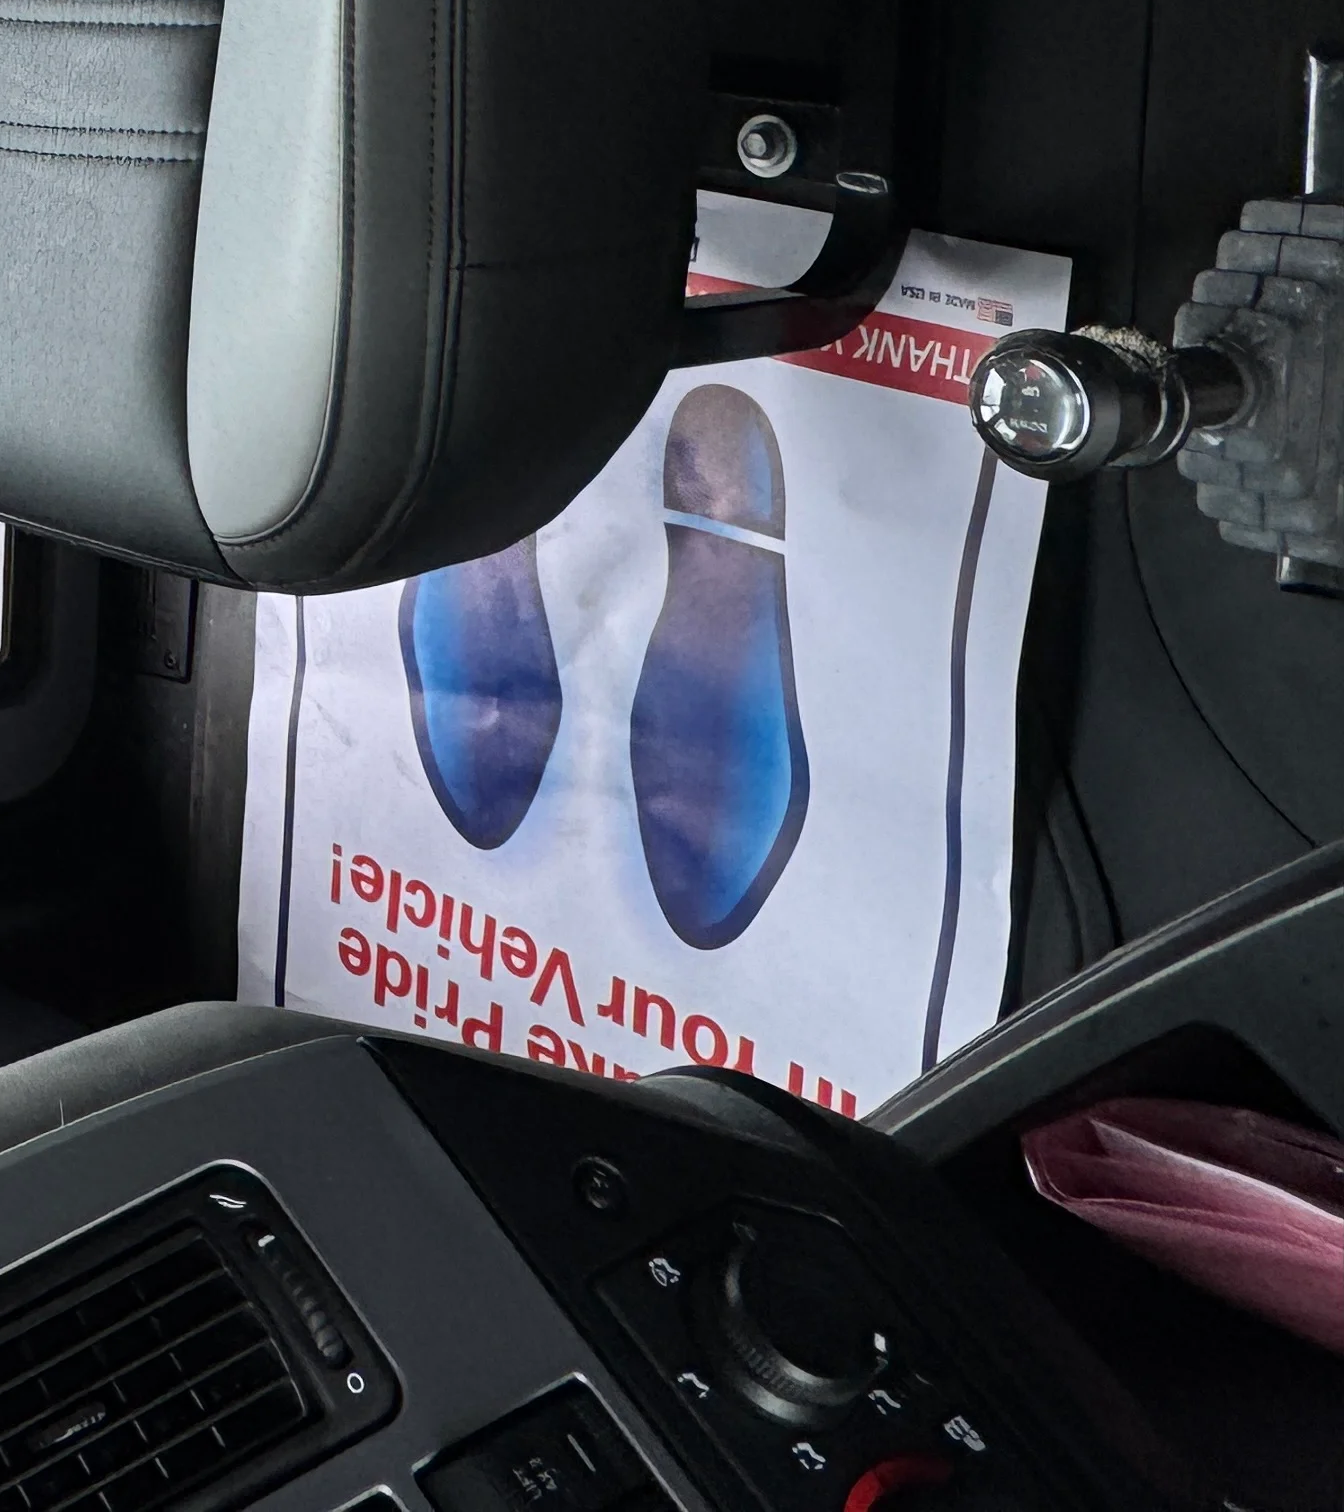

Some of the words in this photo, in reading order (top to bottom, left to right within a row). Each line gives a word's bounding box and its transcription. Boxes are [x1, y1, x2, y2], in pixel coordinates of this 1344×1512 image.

[901, 284, 925, 300] USA
[852, 324, 971, 385] THANK
[331, 843, 582, 1023] Vehicle!
[340, 930, 502, 1051] Pride
